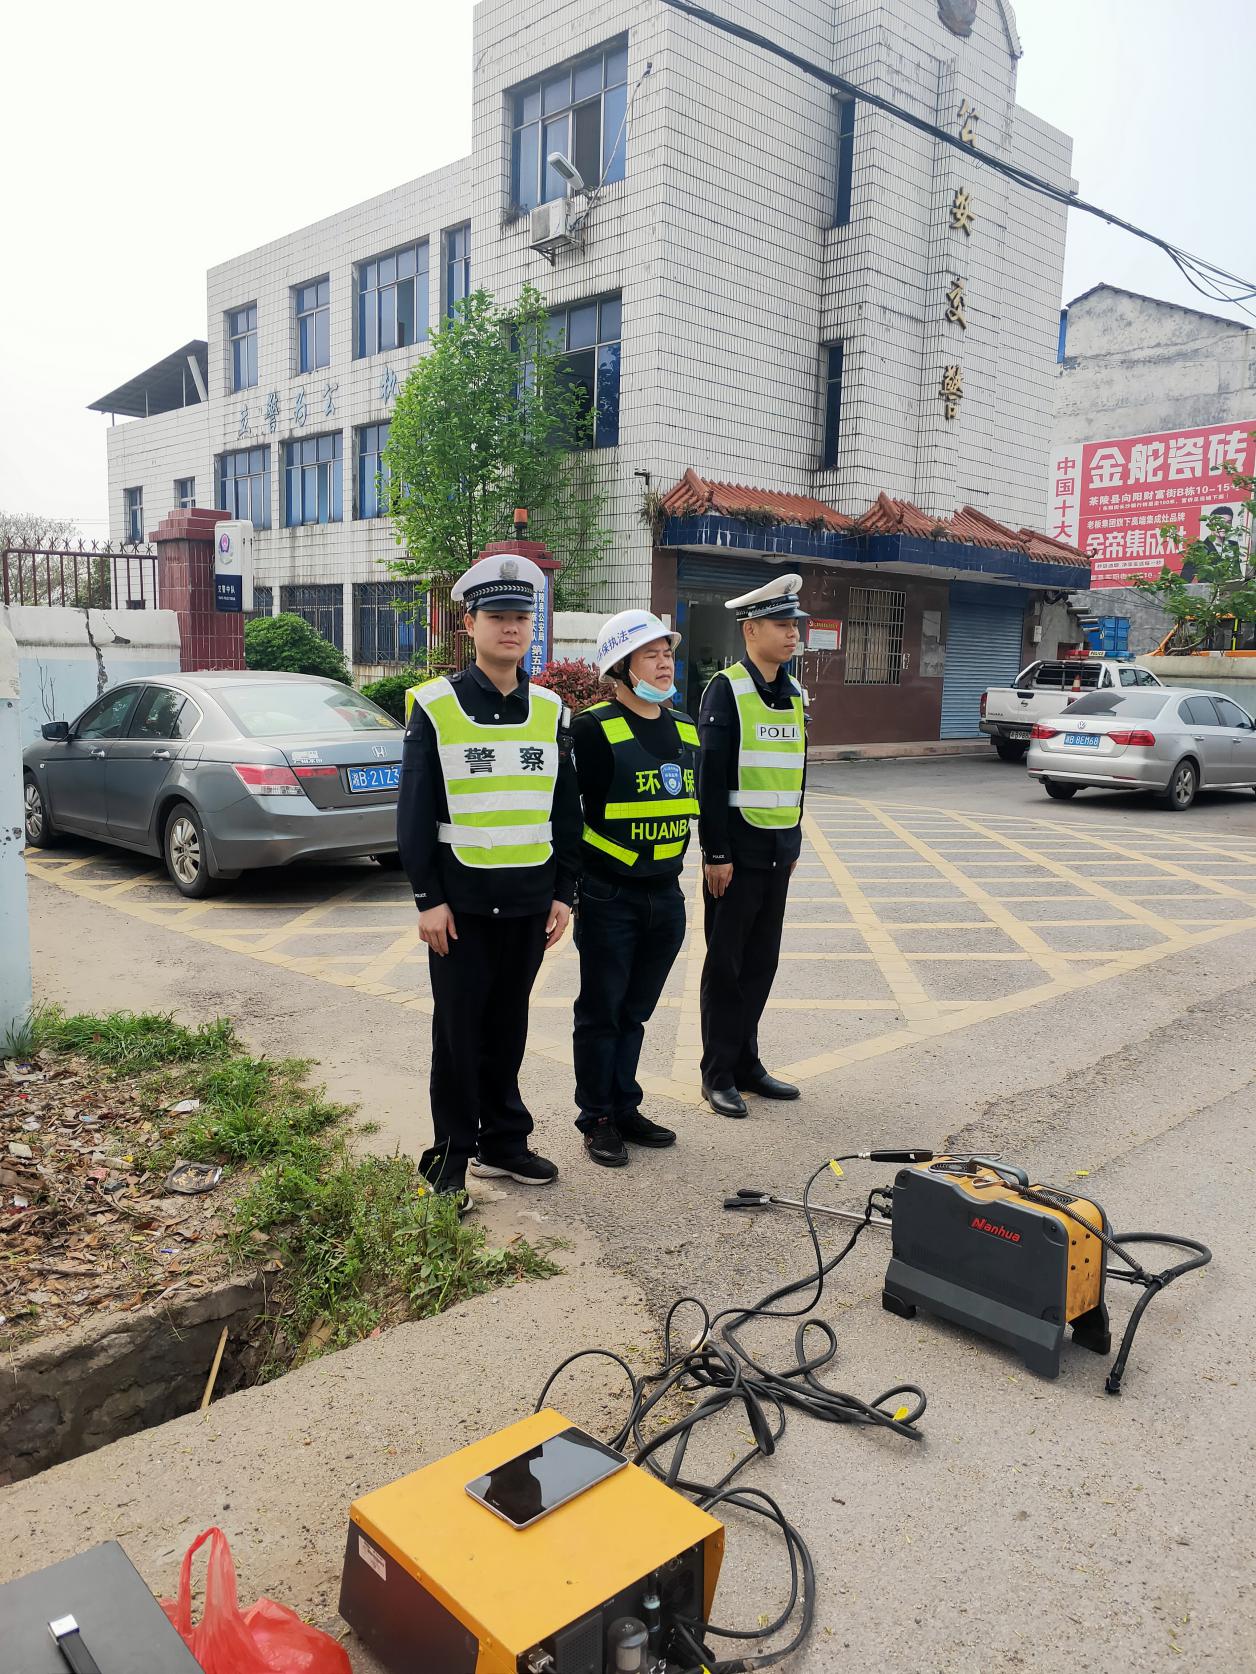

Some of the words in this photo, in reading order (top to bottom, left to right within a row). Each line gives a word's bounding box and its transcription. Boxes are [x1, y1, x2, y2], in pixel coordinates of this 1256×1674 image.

[938, 98, 982, 421] 公安交警
[1088, 430, 1248, 489] 金舵瓷砖
[463, 746, 545, 774] 警察
[631, 818, 690, 841] HUANB
[970, 1217, 1021, 1242] Nanhua
